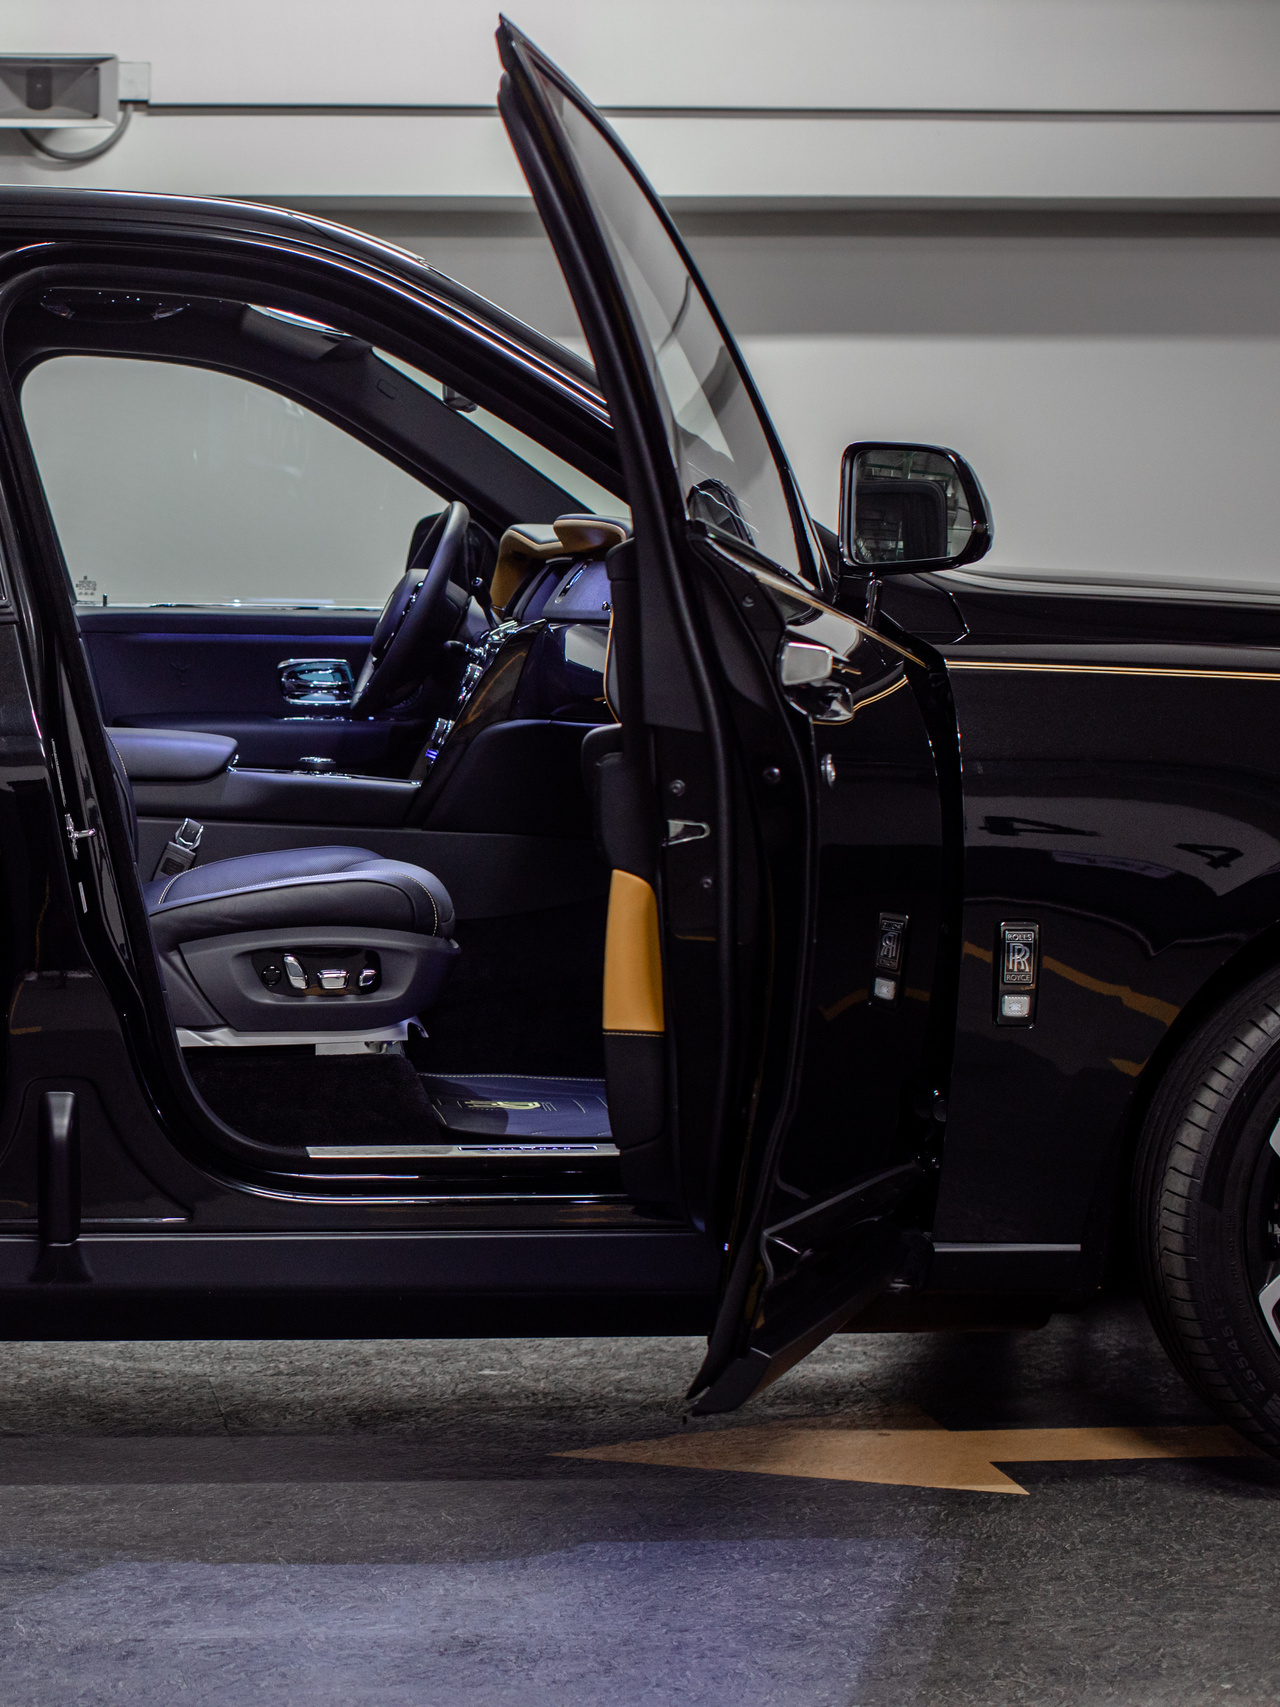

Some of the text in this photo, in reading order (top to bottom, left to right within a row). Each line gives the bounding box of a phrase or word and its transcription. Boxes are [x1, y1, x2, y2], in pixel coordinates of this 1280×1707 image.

[1007, 932, 1032, 941] ROLLS
[1008, 943, 1031, 972] RR
[1006, 974, 1031, 982] ROYCE
